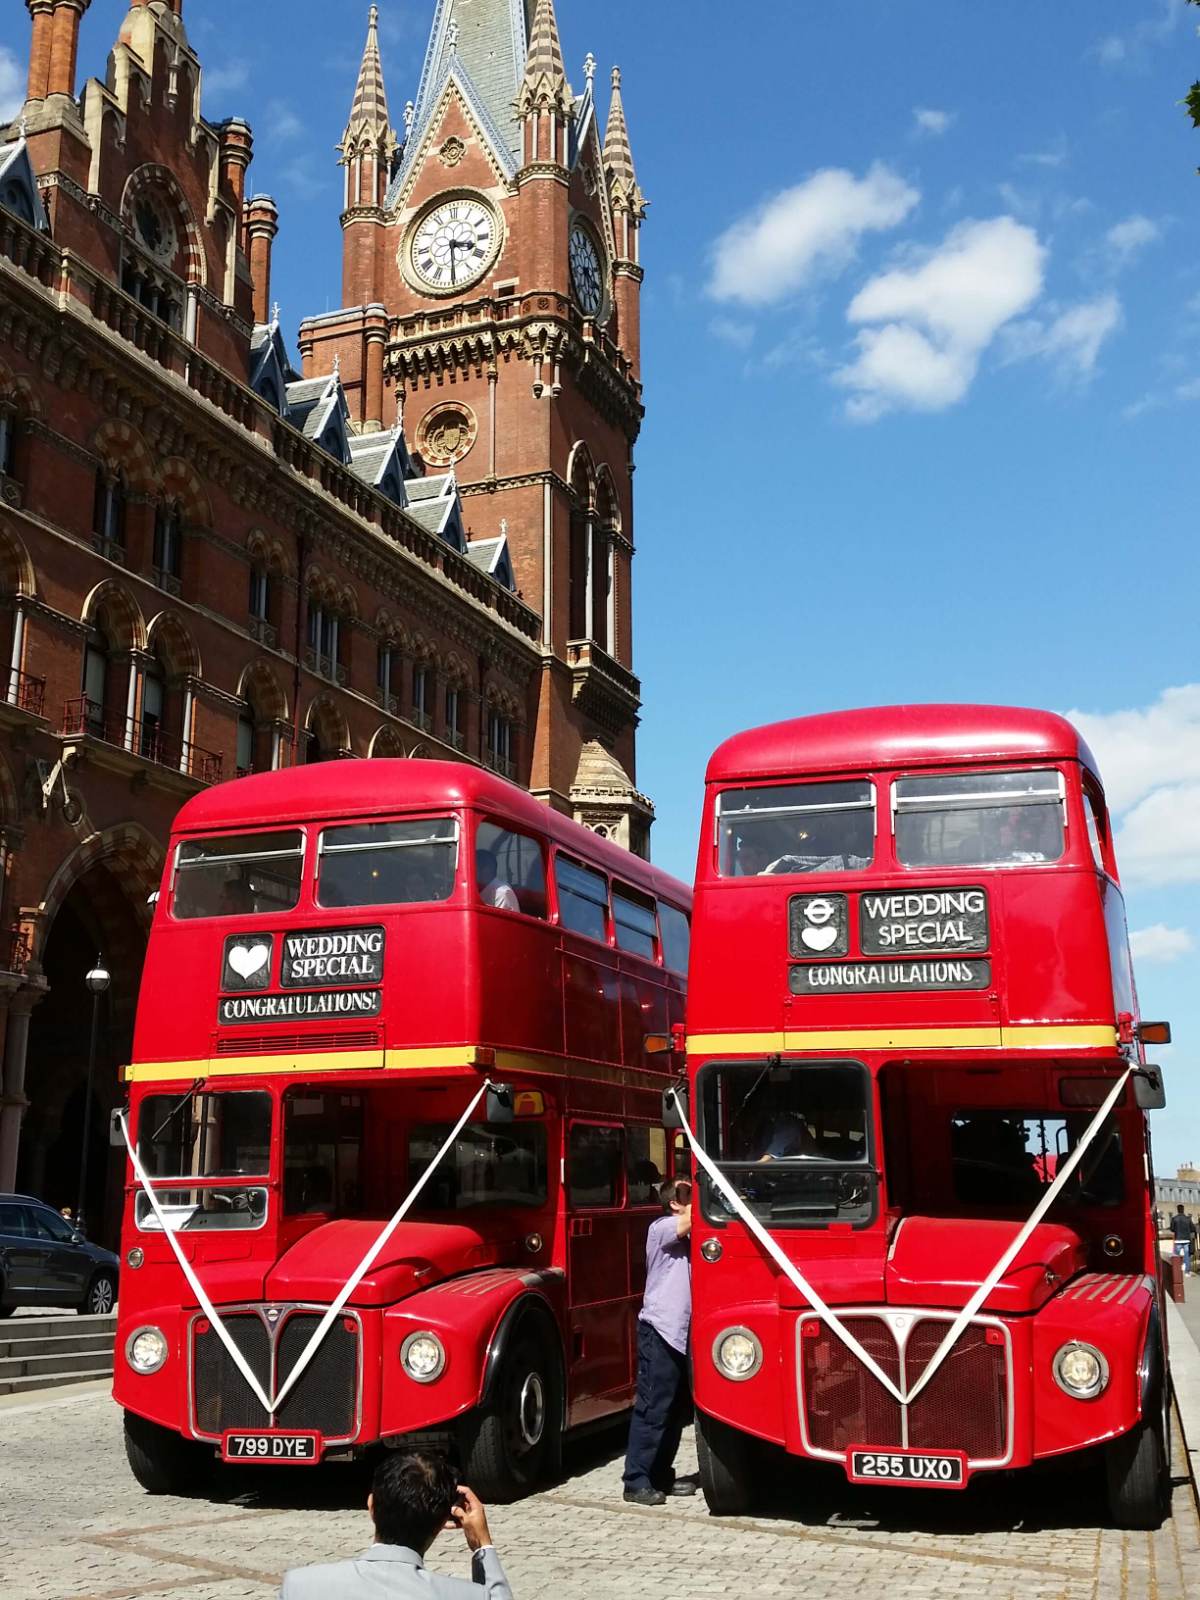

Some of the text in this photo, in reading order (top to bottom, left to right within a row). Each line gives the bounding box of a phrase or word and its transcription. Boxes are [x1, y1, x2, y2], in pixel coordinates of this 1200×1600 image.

[863, 891, 984, 919] WEDDING
[878, 921, 973, 945] SPECIAL
[287, 933, 382, 959] WEDDING
[291, 955, 374, 978] SPECIAL
[223, 992, 377, 1019] CONGRATULATIONS!
[234, 1438, 307, 1456] 799 DYE
[862, 1456, 904, 1476] 255
